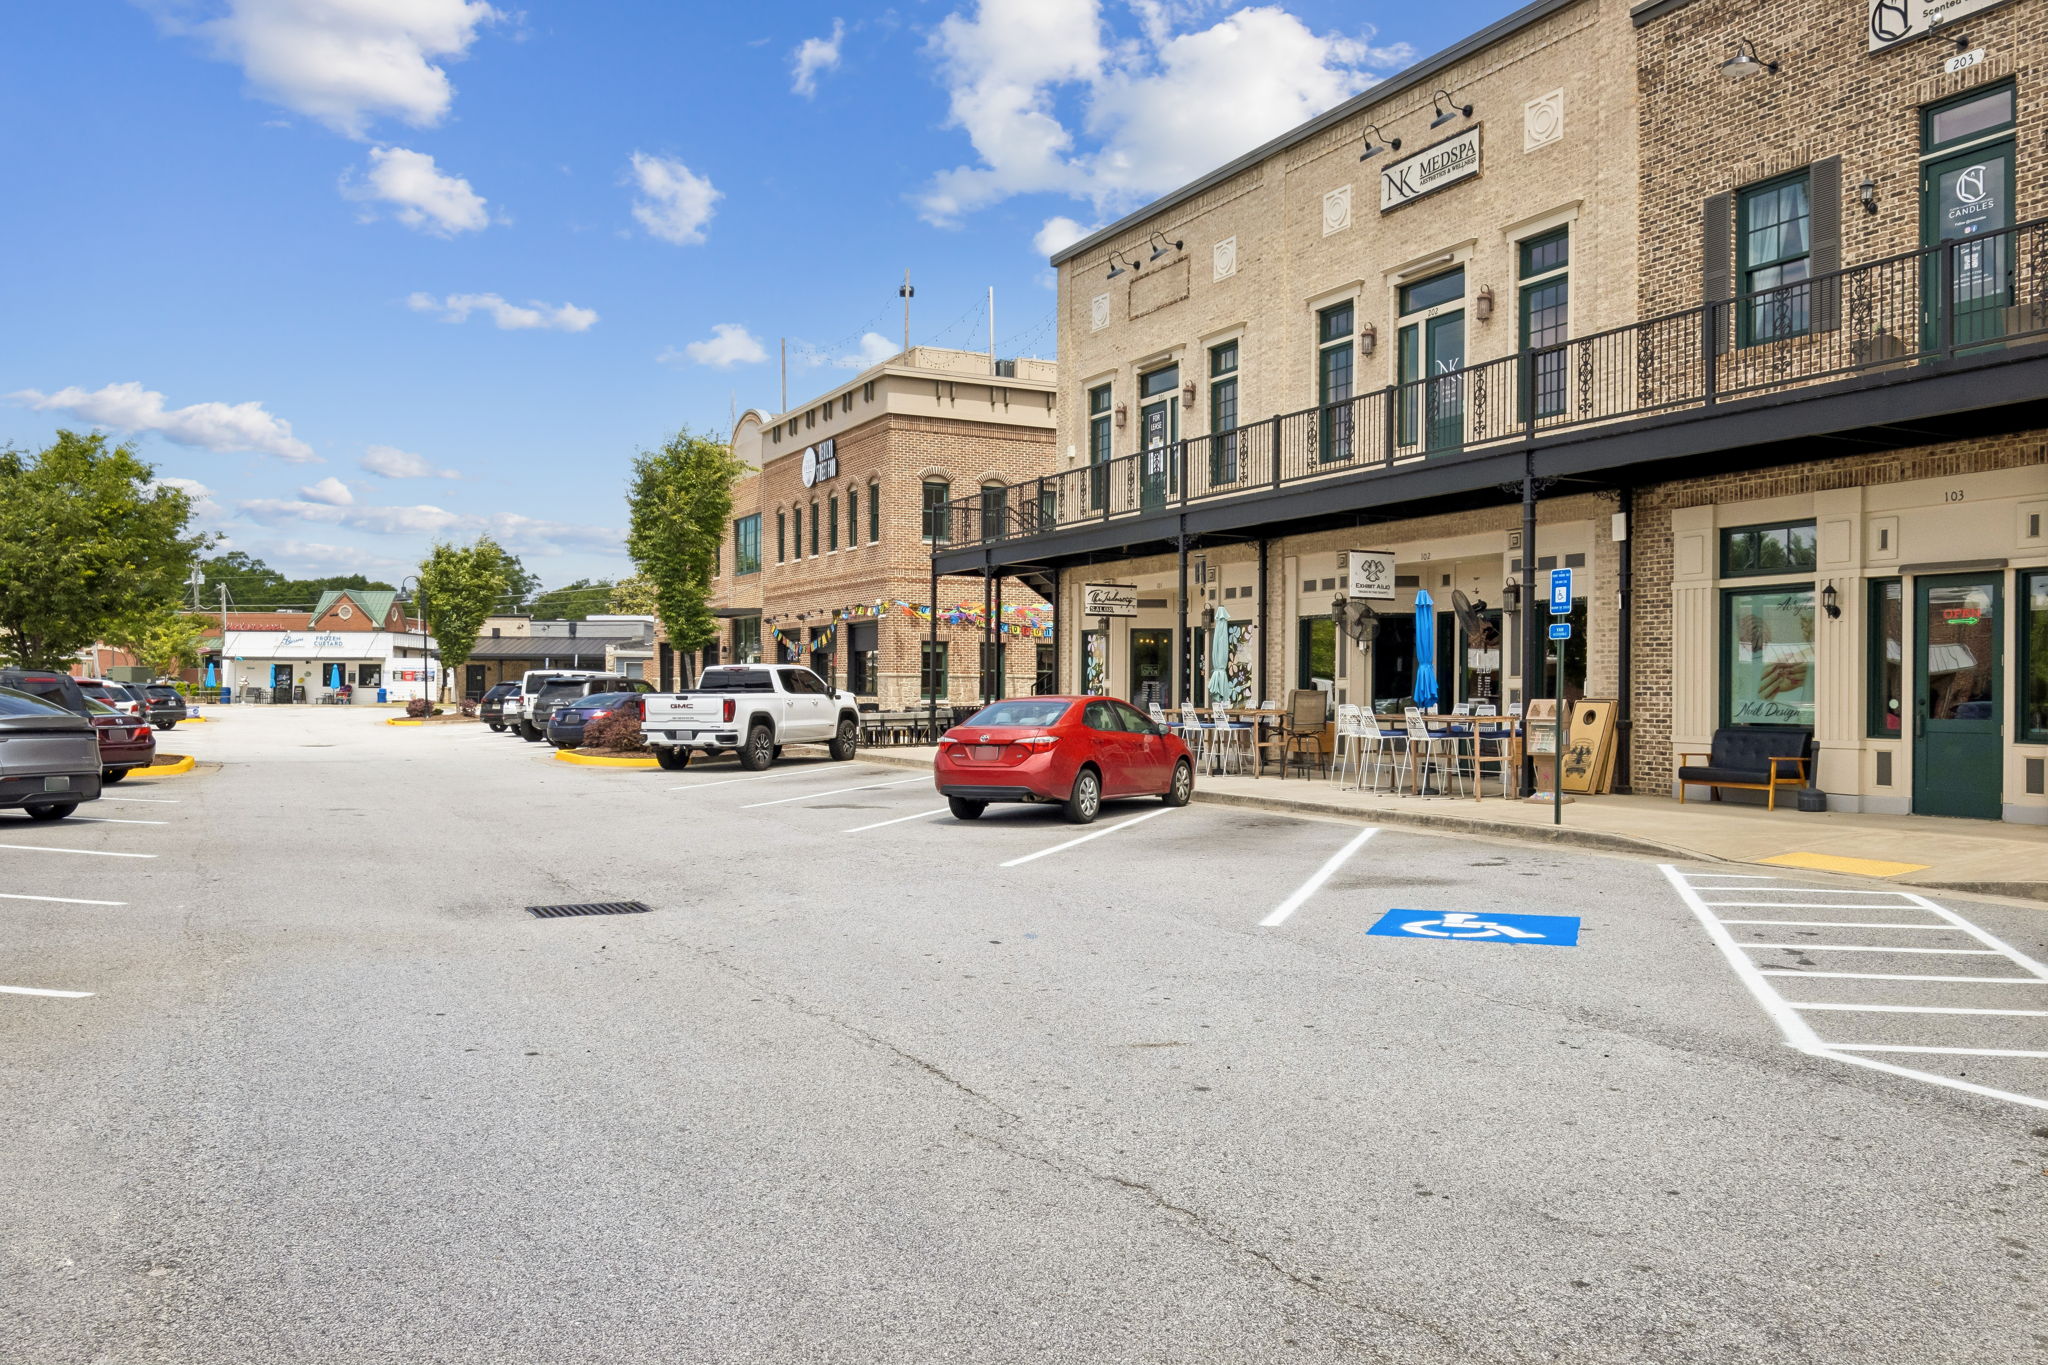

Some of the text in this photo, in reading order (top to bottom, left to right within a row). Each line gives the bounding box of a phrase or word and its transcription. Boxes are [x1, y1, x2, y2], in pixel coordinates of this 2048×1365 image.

[1952, 54, 1974, 70] 203
[1419, 140, 1476, 177] MEDSPA
[1948, 200, 1995, 219] CANDLES
[1152, 413, 1161, 422] FOR
[1150, 421, 1162, 431] LEASE
[1944, 490, 1965, 503] 103
[1421, 552, 1431, 560] 102
[1942, 608, 1981, 619] OPEN
[1736, 701, 1800, 721] Nail Design
